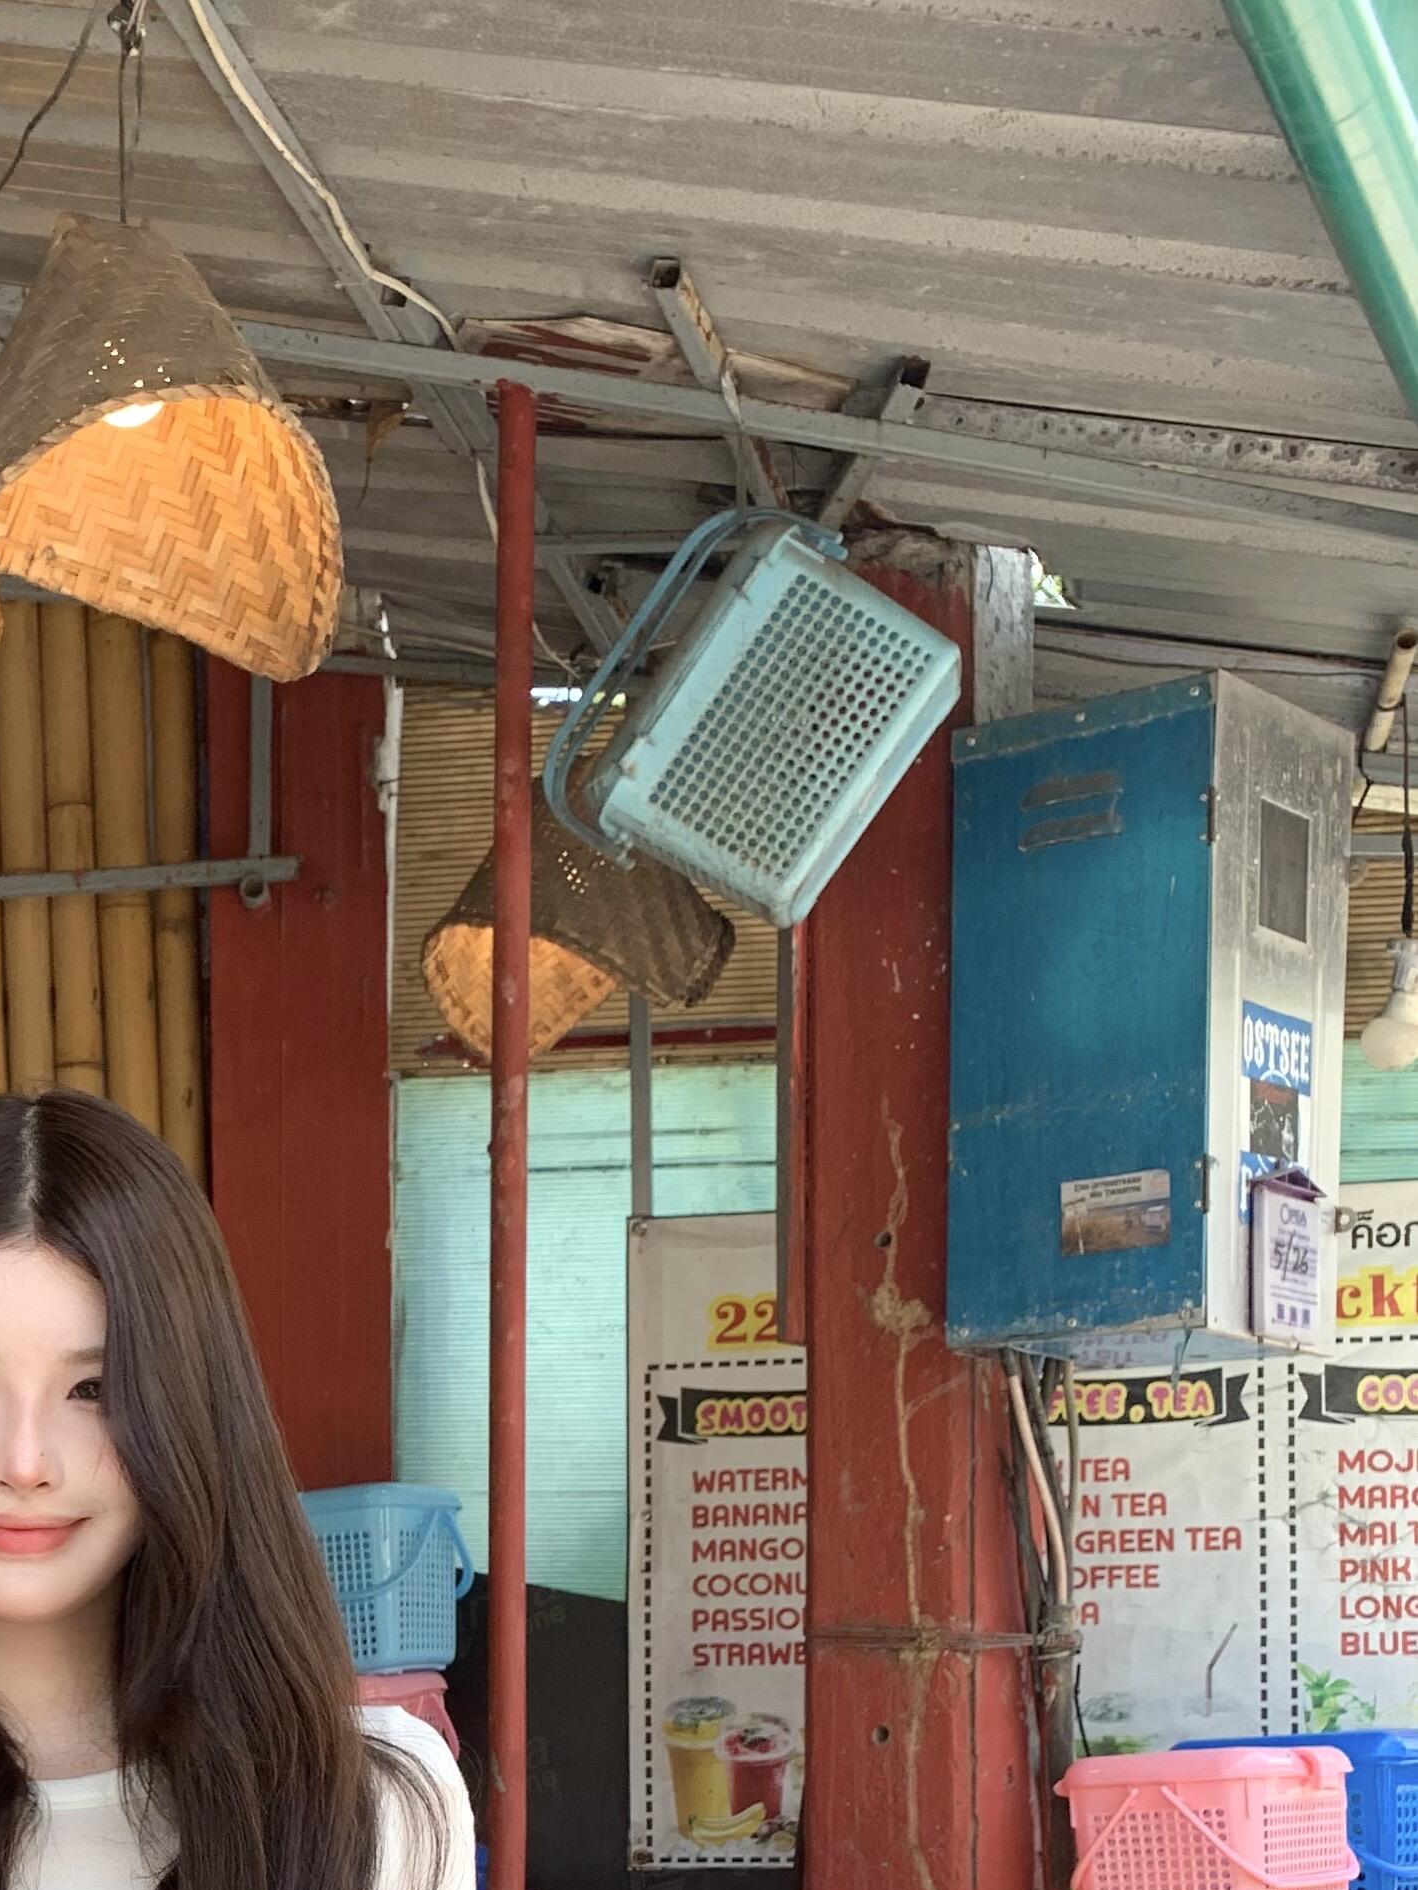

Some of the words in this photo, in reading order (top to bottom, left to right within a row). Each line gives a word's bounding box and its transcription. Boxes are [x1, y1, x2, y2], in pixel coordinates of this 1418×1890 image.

[1242, 1014, 1311, 1083] OSTSEE
[1079, 1457, 1131, 1483] TEA
[692, 1502, 807, 1529] BANANA
[1110, 1492, 1168, 1518] TEA
[1074, 1527, 1175, 1555] GREEN
[1184, 1526, 1243, 1552] TEA
[1338, 1520, 1398, 1548] MAI
[692, 1537, 805, 1563] MANGO
[1339, 1556, 1412, 1583] PINK
[692, 1607, 807, 1632] PASSIO
[1340, 1630, 1418, 1657] BLUE
